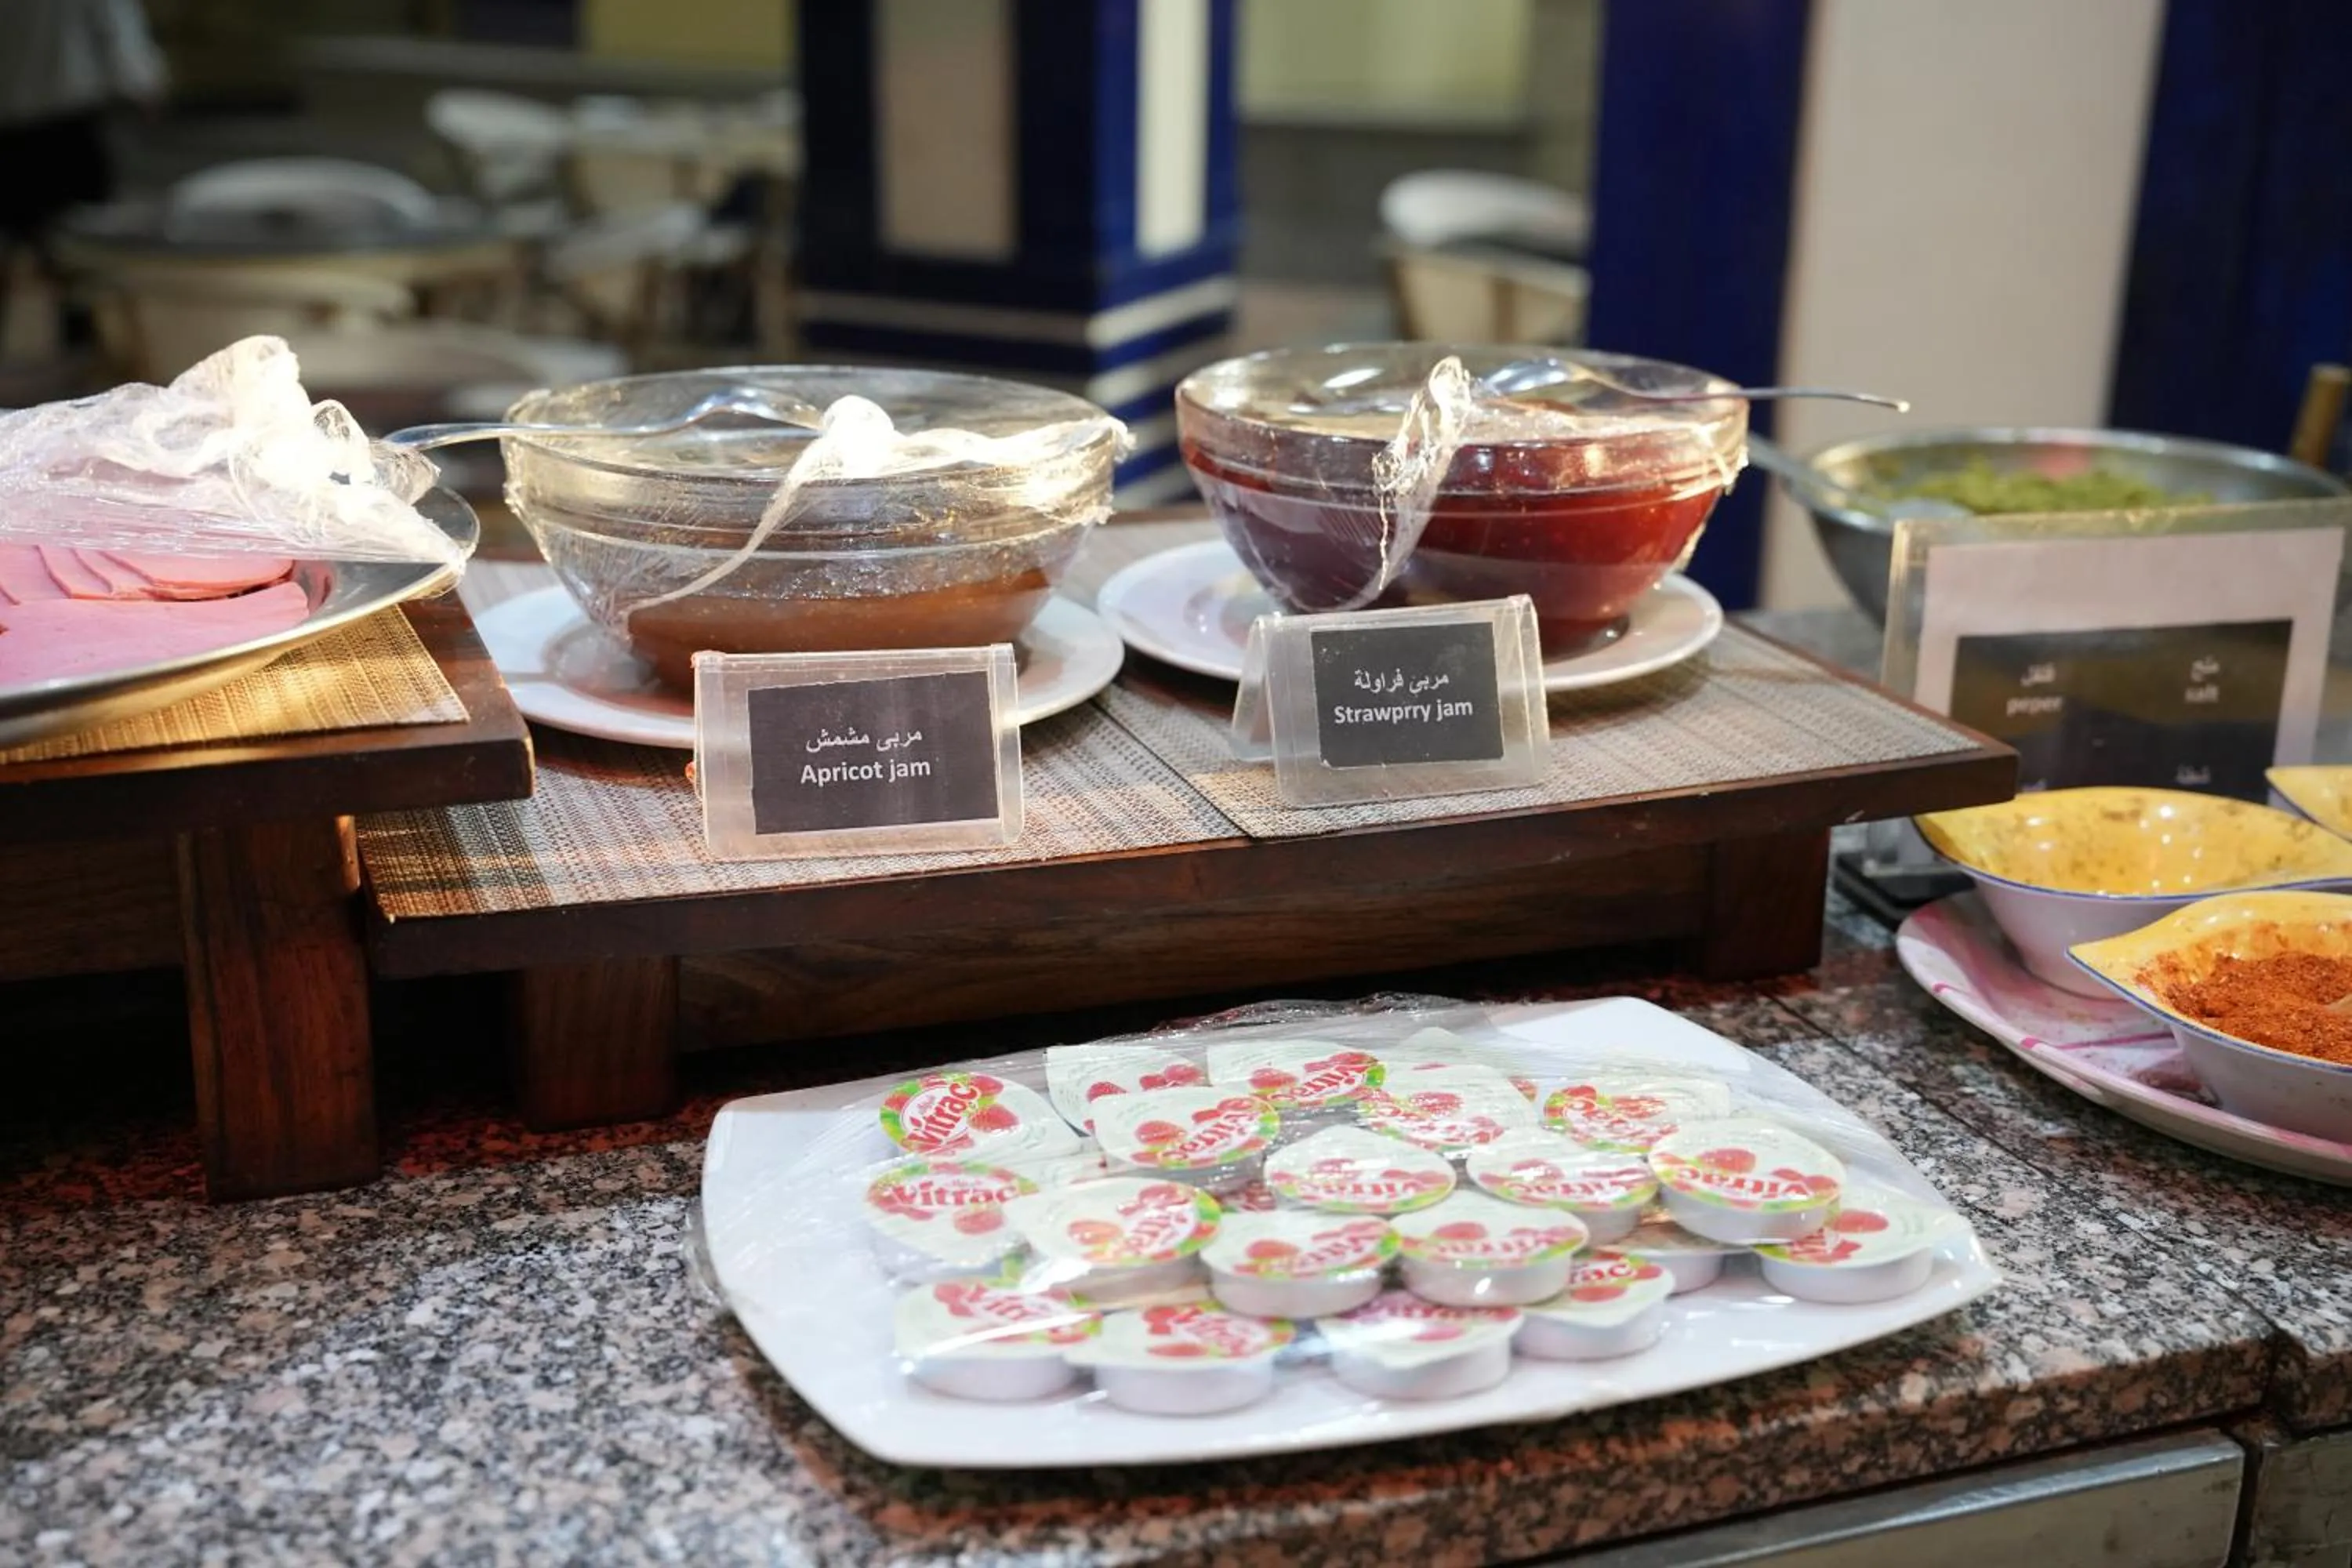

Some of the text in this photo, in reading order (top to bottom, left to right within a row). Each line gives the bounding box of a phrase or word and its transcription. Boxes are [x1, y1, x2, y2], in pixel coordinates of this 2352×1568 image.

[1354, 668, 1404, 693] فراولة
[1334, 699, 1473, 724] Strawprry jam
[805, 727, 869, 753] مشمش
[800, 758, 931, 787] Apricot jam
